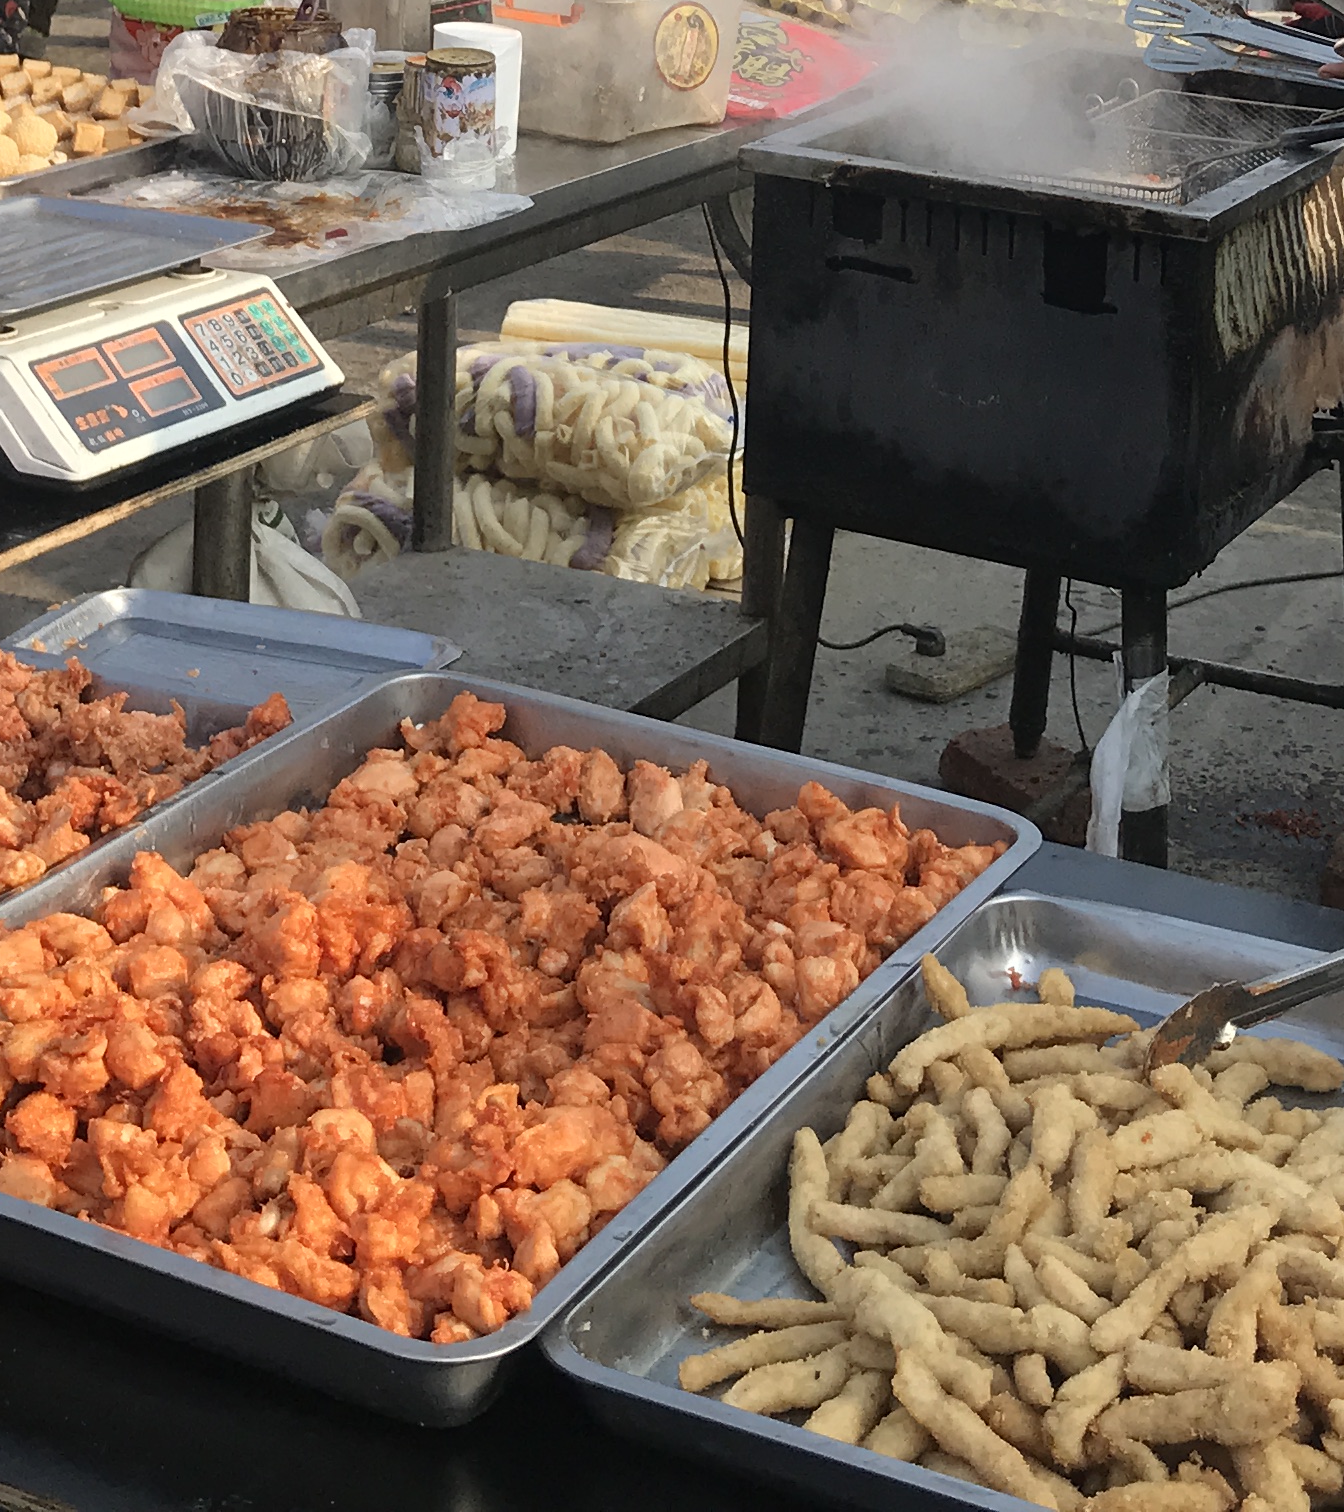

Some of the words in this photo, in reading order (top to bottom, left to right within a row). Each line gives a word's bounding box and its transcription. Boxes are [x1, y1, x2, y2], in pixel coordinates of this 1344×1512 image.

[194, 323, 206, 336] 7
[207, 318, 222, 332] 8
[222, 314, 235, 327] 9
[209, 339, 220, 353] 4
[220, 335, 234, 349] 5
[235, 329, 248, 343] 6
[220, 356, 231, 370] 1
[232, 351, 245, 365] 2
[246, 346, 259, 360] 3
[230, 372, 244, 386] 0
